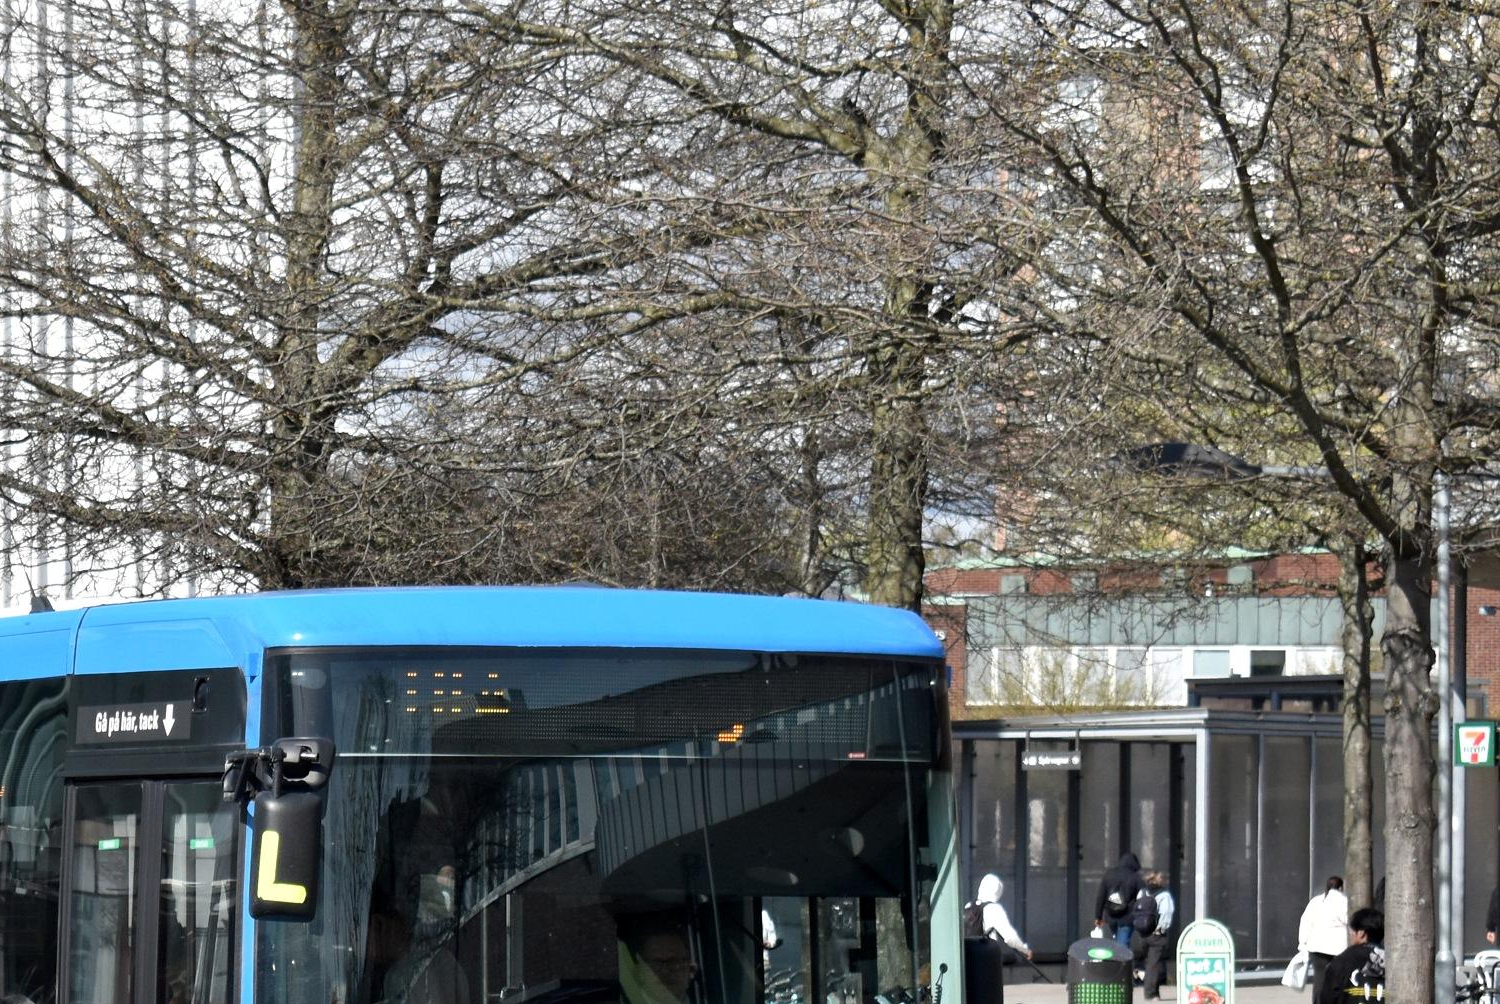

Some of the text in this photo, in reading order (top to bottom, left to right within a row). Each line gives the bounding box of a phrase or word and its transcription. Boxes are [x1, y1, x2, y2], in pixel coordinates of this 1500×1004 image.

[95, 709, 159, 737] Gå på här, tack
